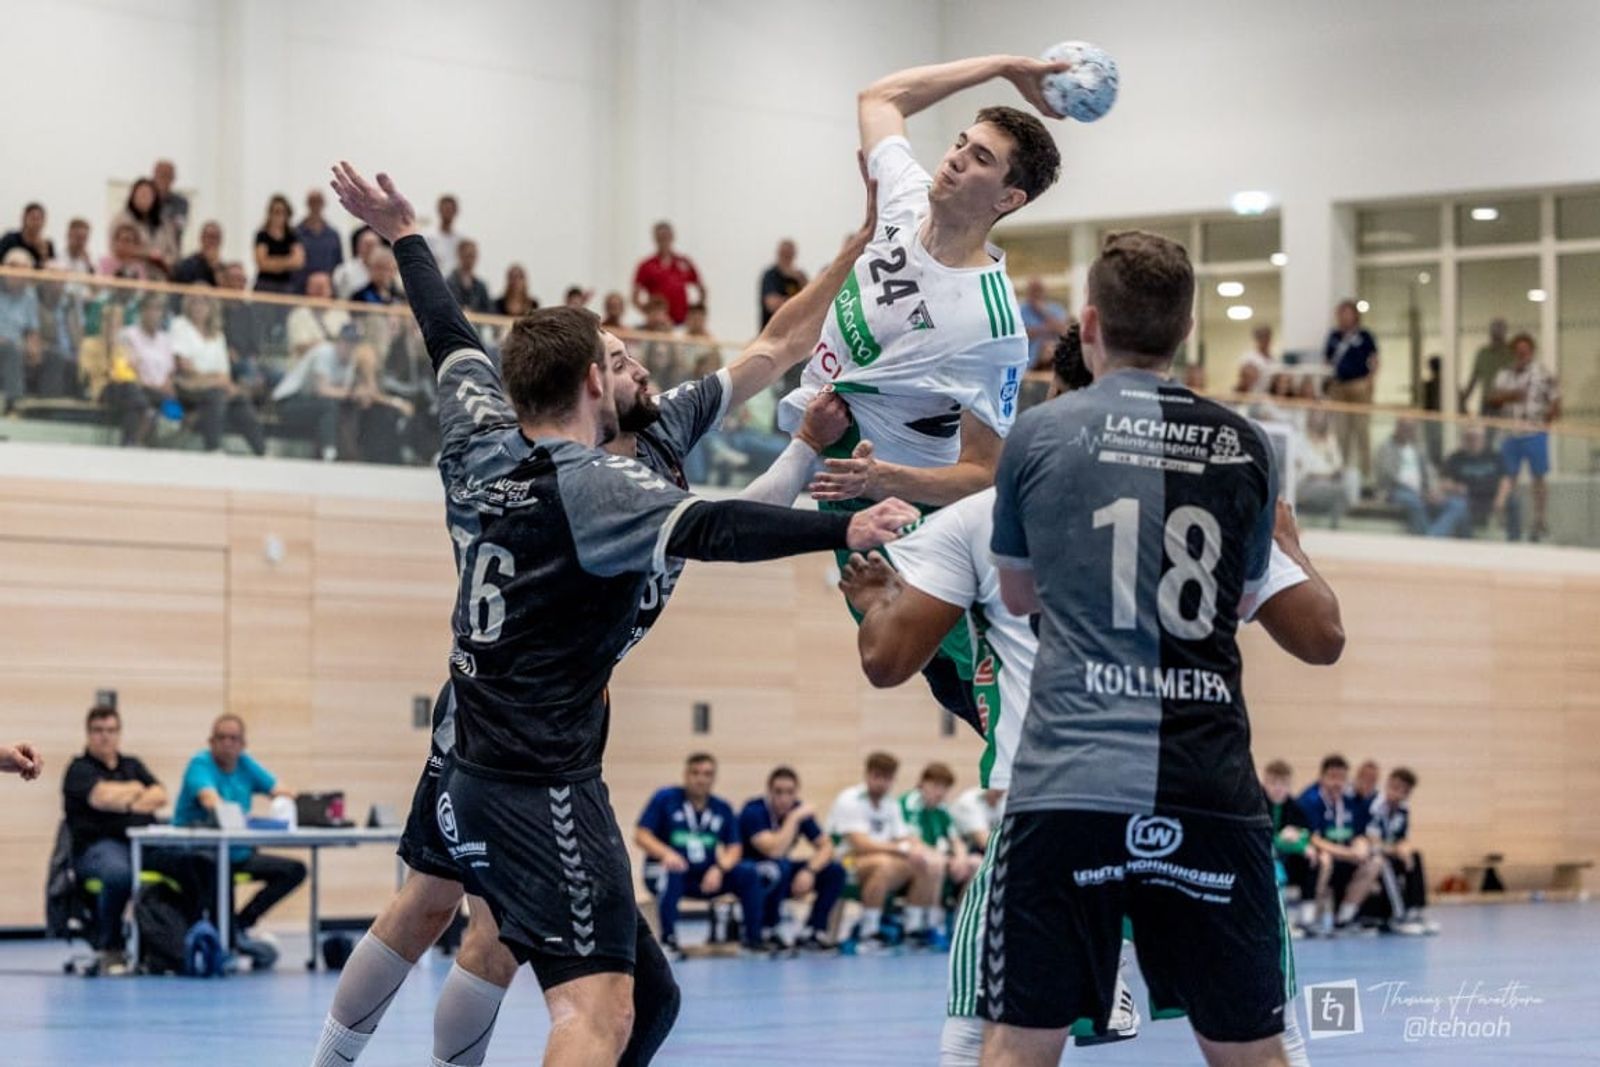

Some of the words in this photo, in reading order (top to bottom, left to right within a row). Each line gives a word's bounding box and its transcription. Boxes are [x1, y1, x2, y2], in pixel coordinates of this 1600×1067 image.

[869, 246, 920, 307] 24
[836, 288, 873, 361] pharma
[1105, 413, 1215, 445] LACHNET
[1092, 497, 1222, 641] 18
[1085, 660, 1233, 705] KOLLMEIER
